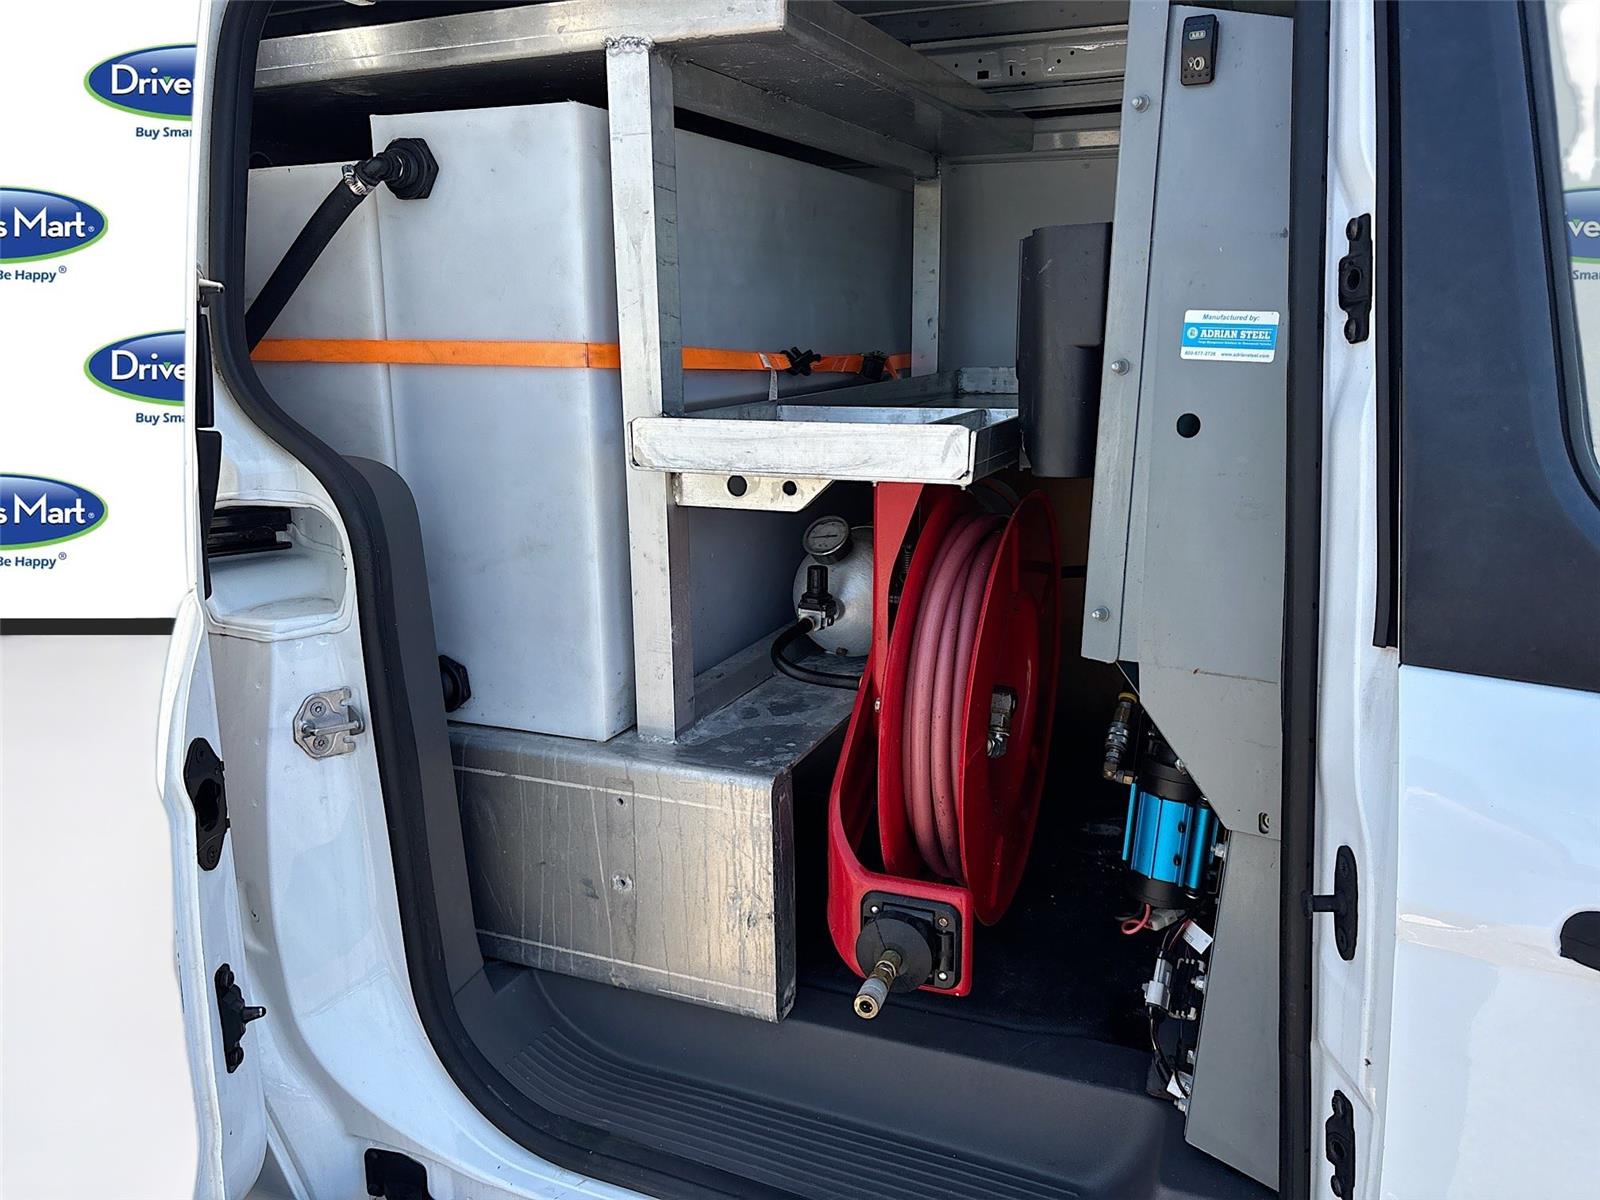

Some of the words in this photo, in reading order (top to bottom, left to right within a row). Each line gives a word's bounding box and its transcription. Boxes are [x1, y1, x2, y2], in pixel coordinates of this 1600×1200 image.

[136, 127, 160, 140] Buy
[14, 206, 85, 238] Mart
[1200, 329, 1237, 339] ADRIAN
[1240, 330, 1271, 340] STEEL
[136, 412, 160, 426] Buy
[14, 492, 85, 525] Mart
